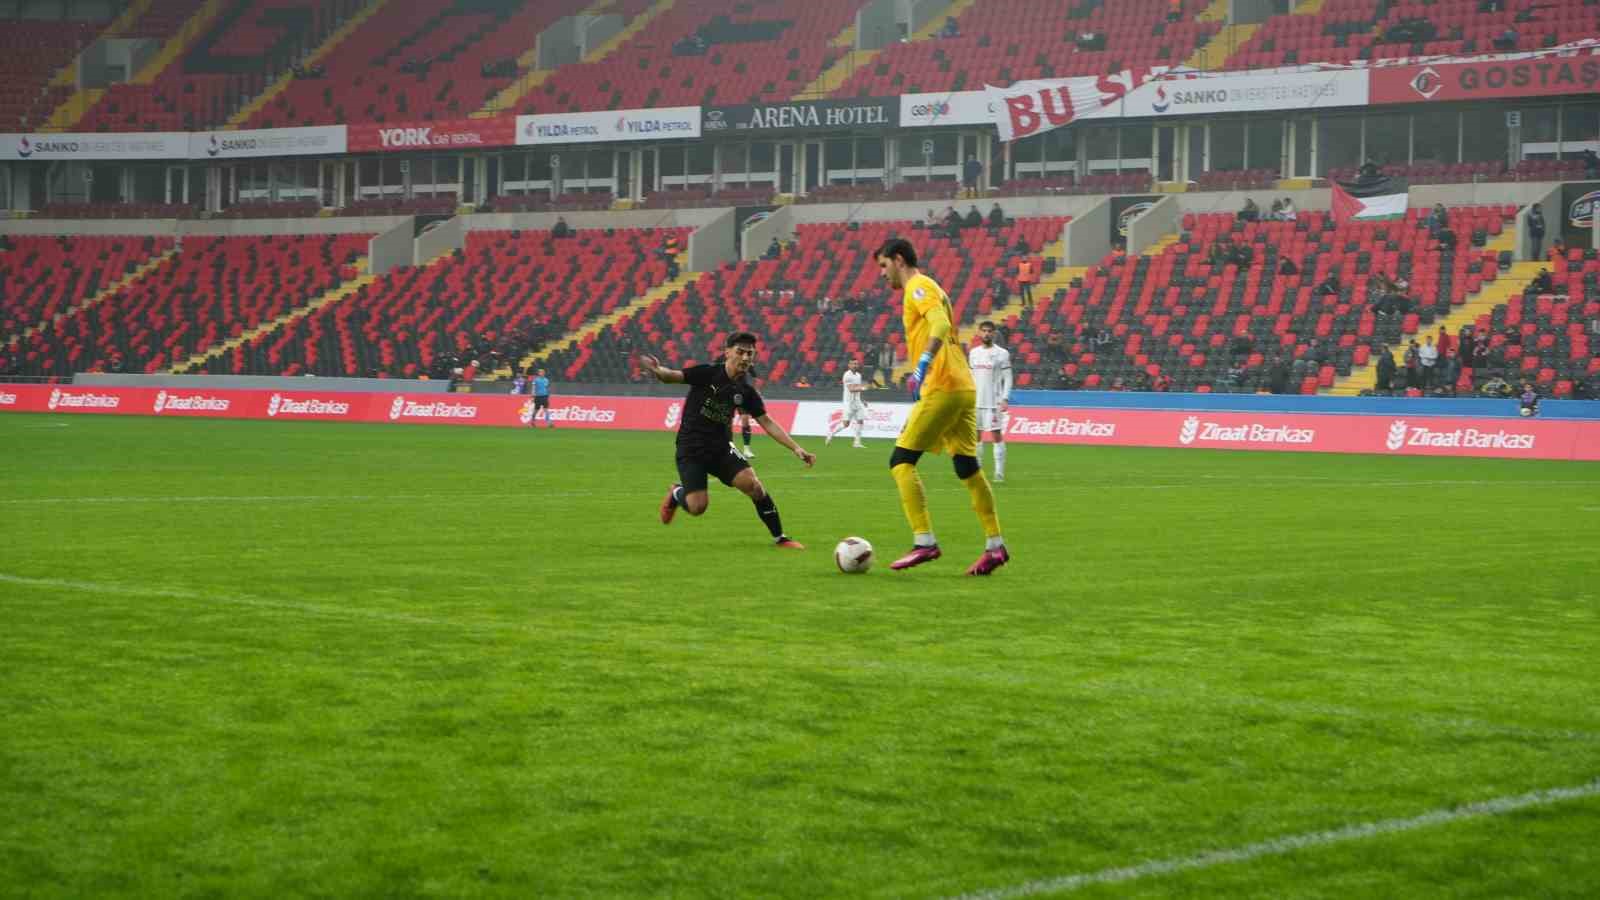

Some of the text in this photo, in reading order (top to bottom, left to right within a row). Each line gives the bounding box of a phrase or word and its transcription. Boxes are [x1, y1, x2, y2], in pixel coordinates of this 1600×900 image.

[1459, 62, 1600, 91] GOSTAŞ
[1174, 89, 1227, 105] SANKO
[750, 105, 889, 128] ARENA HOTEL
[1003, 86, 1075, 138] BU
[538, 124, 569, 137] YILDA
[627, 120, 693, 133] YILDA PETROL
[379, 127, 483, 146] YORK CAR RENTAL
[34, 142, 79, 153] SANKO
[222, 139, 257, 151] SANKO
[165, 396, 195, 410] Ziraat
[279, 399, 310, 413] Ziraat
[403, 401, 436, 417] Ziraat
[1009, 416, 1117, 437] Ziraat Bankası
[1199, 422, 1316, 443] Ziraat Bankası
[1407, 427, 1536, 449] Ziraat Bankası
